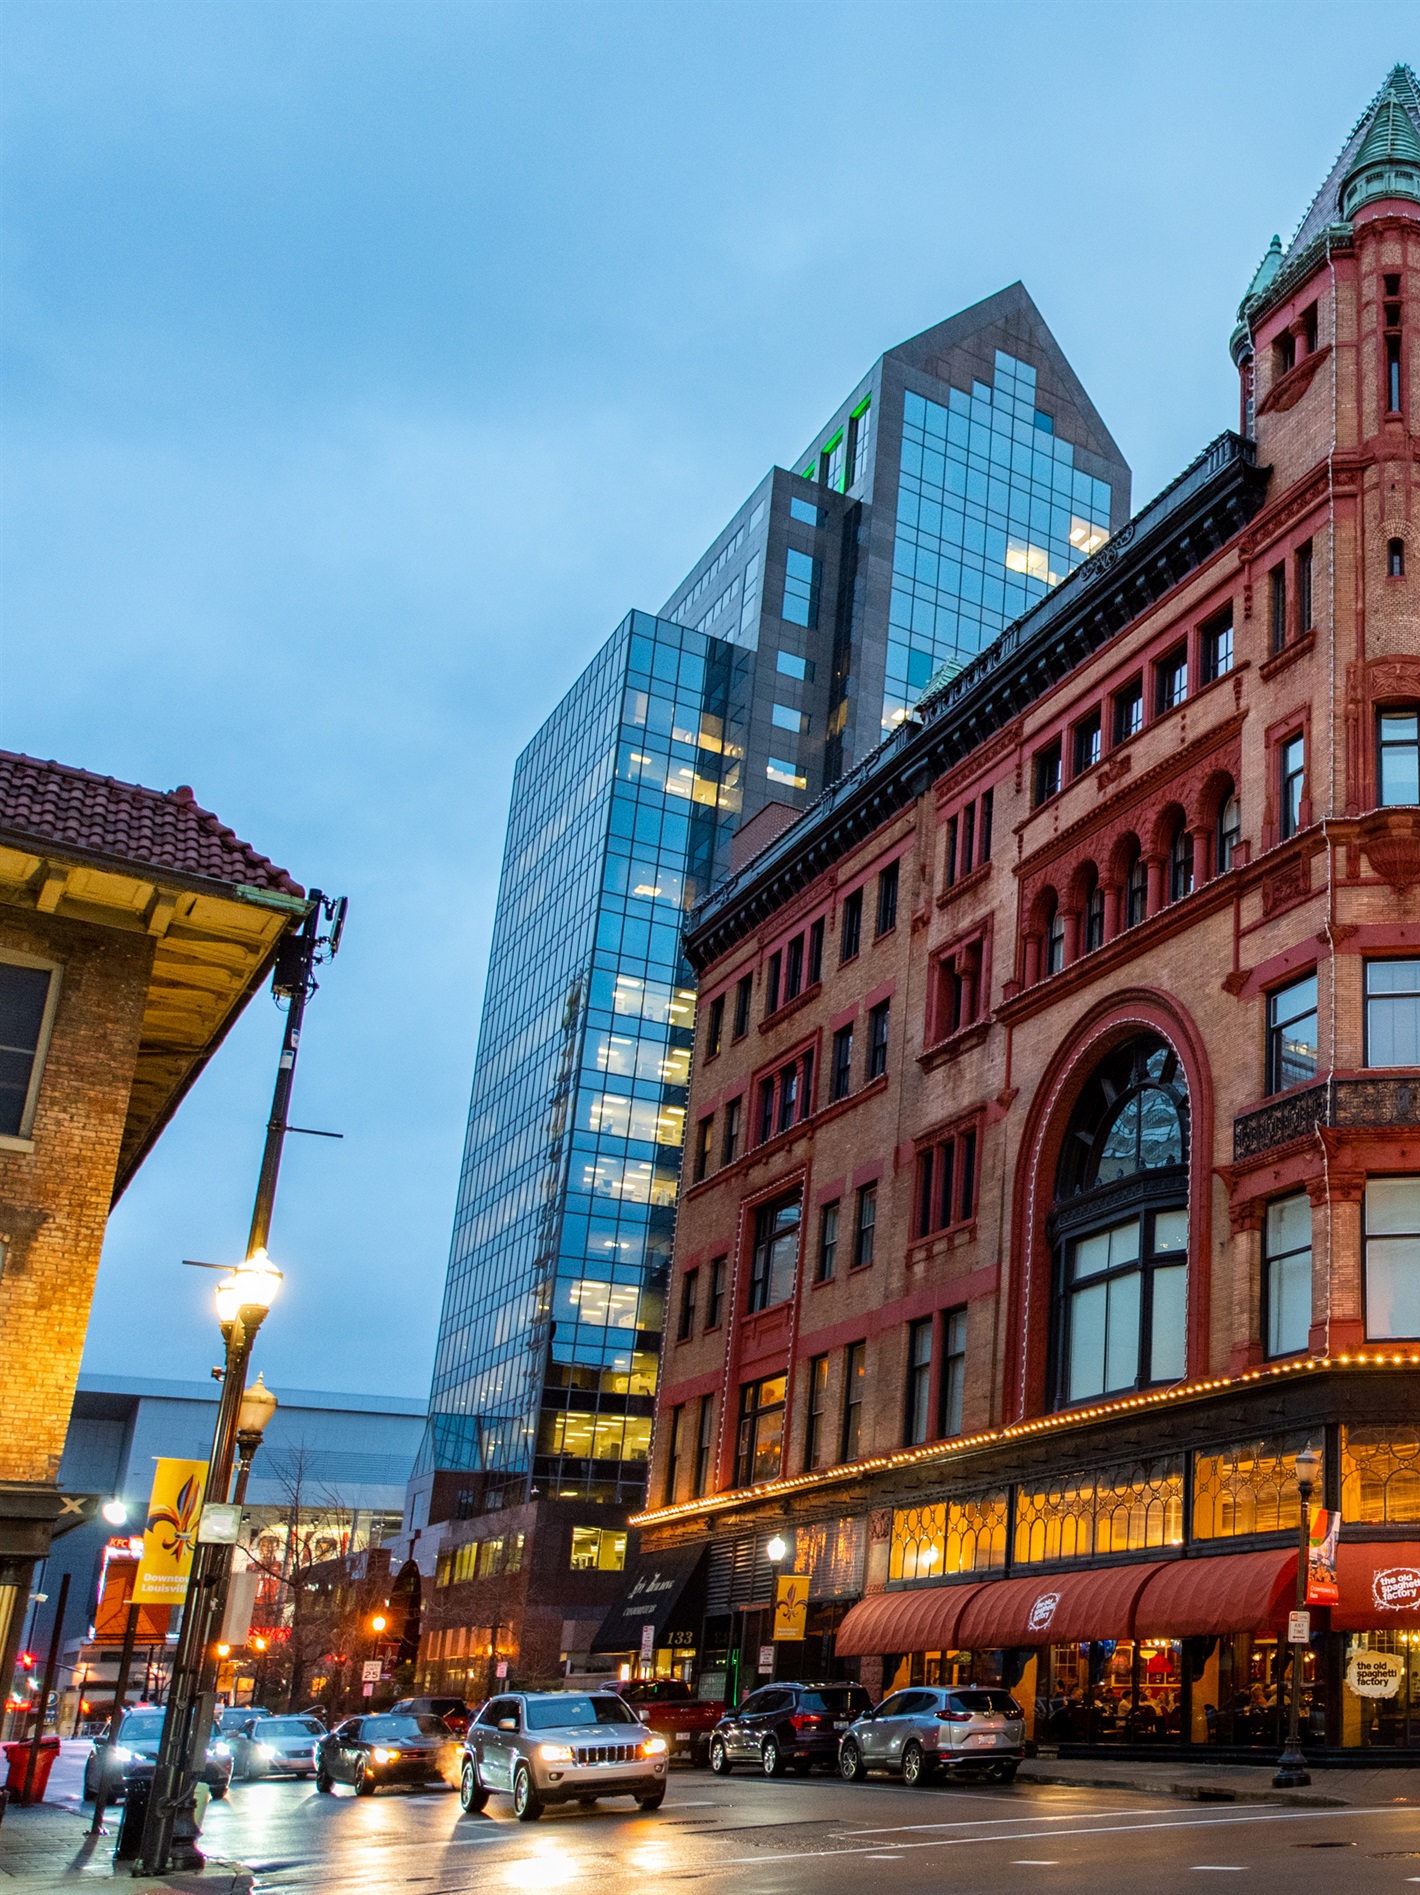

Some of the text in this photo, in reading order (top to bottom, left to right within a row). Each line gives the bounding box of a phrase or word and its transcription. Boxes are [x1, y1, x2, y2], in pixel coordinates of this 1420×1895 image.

[109, 1538, 128, 1548] KFC
[144, 1573, 190, 1583] Downto
[1380, 1574, 1412, 1585] the old
[1382, 1588, 1417, 1600] factory
[666, 1631, 693, 1645] 133
[1357, 1662, 1387, 1670] the old
[364, 1671, 378, 1679] 25
[1357, 1669, 1397, 1679] spaghetti
[1357, 1677, 1389, 1687] factory
